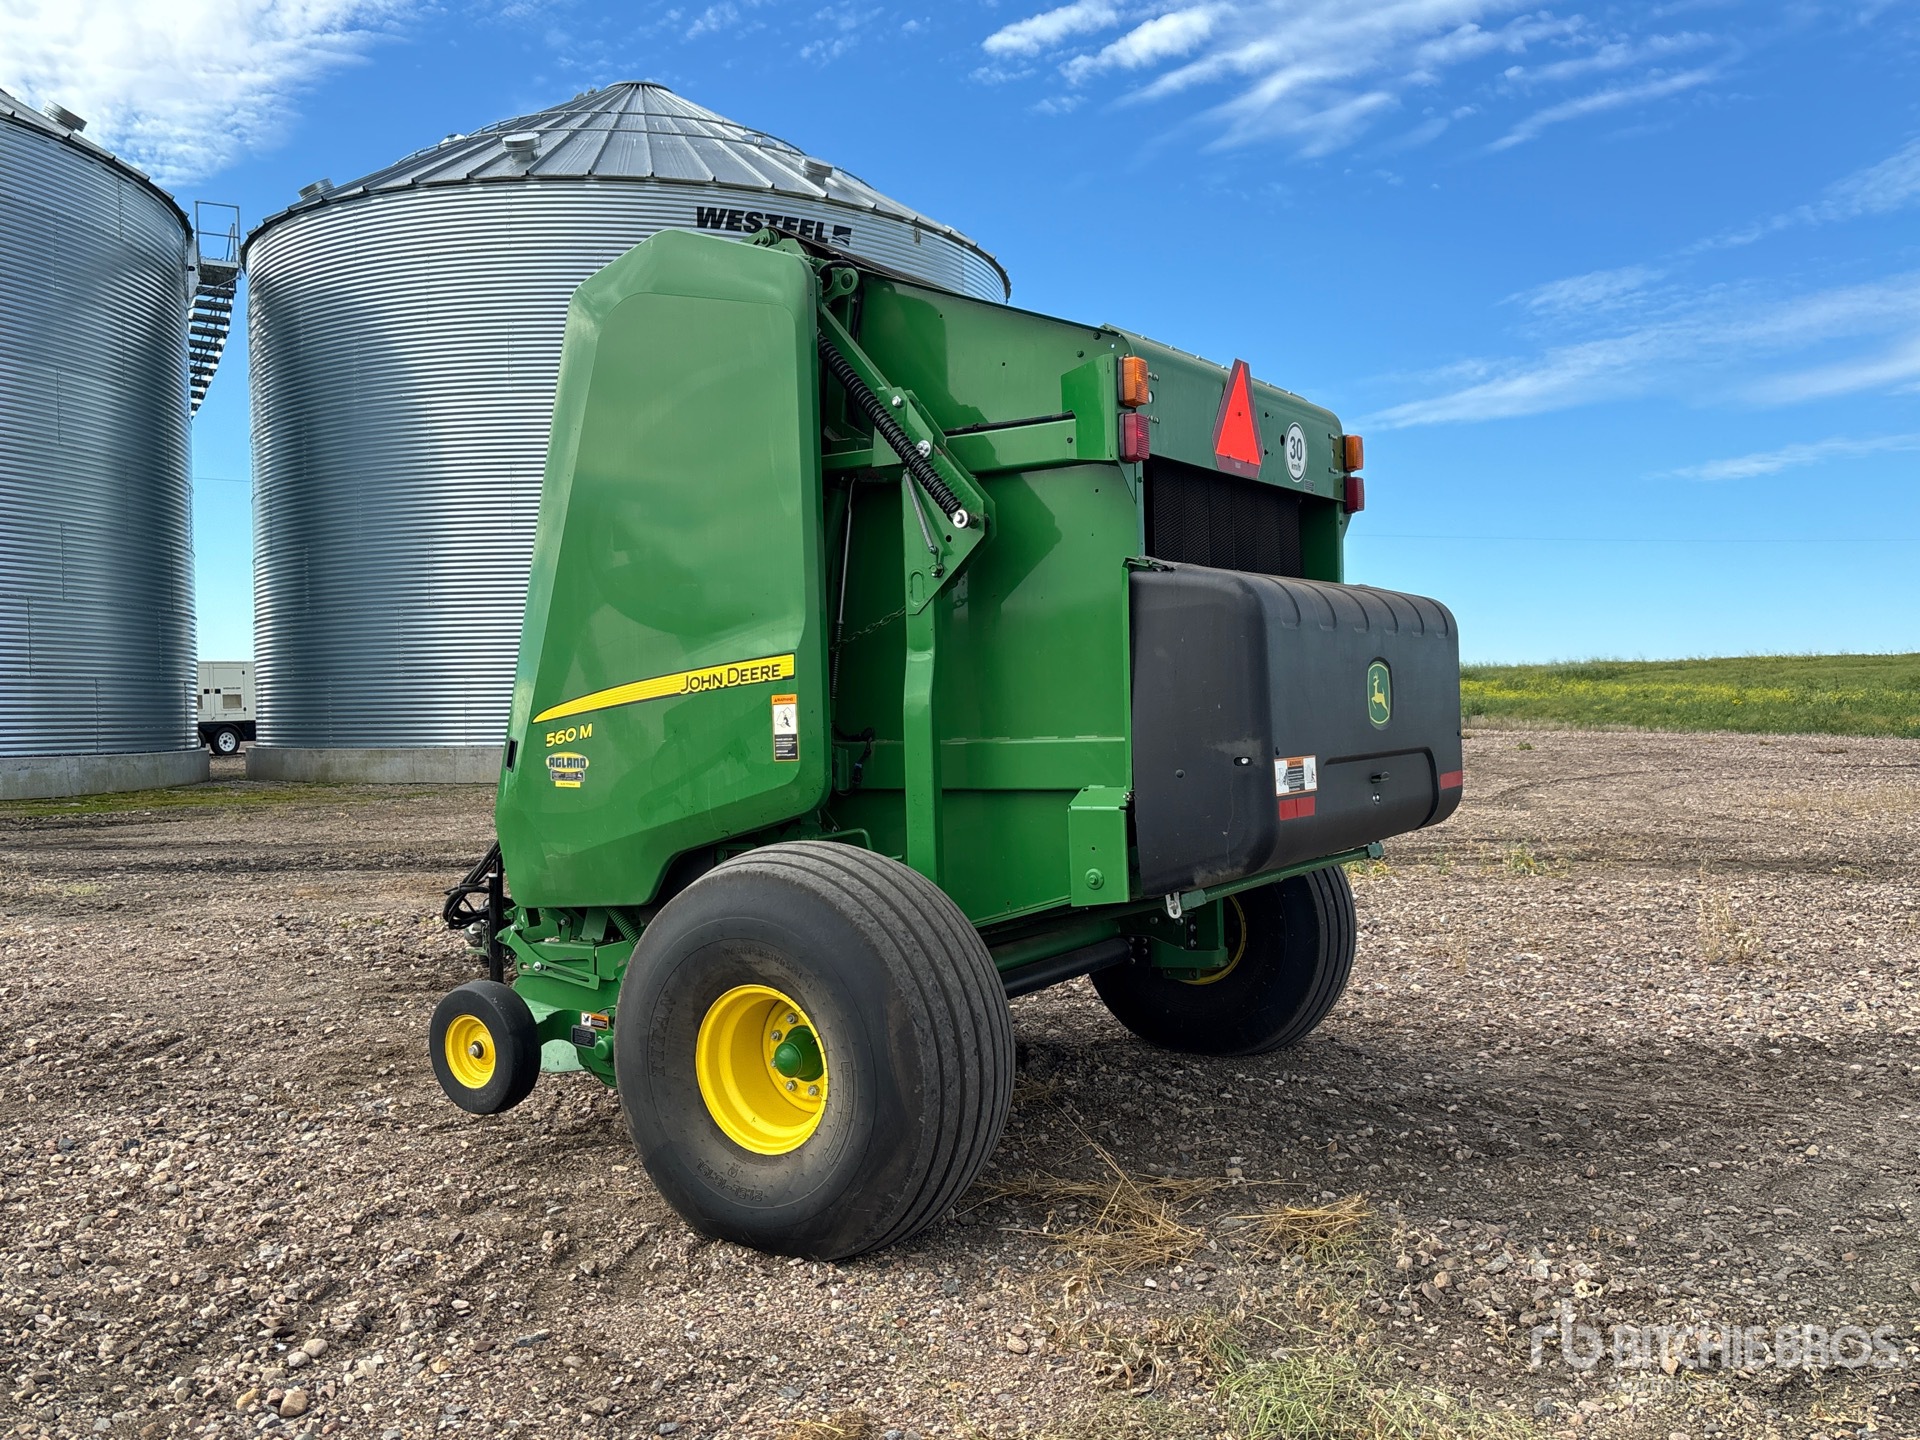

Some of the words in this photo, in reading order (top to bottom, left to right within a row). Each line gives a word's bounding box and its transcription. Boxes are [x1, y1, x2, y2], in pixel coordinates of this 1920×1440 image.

[696, 206, 829, 244] WESTEEL
[1290, 436, 1303, 461] 30
[680, 673, 724, 693] JOHN
[726, 663, 782, 685] DEERE
[545, 726, 578, 748] 560
[578, 722, 594, 741] M
[548, 757, 588, 769] AGLAND
